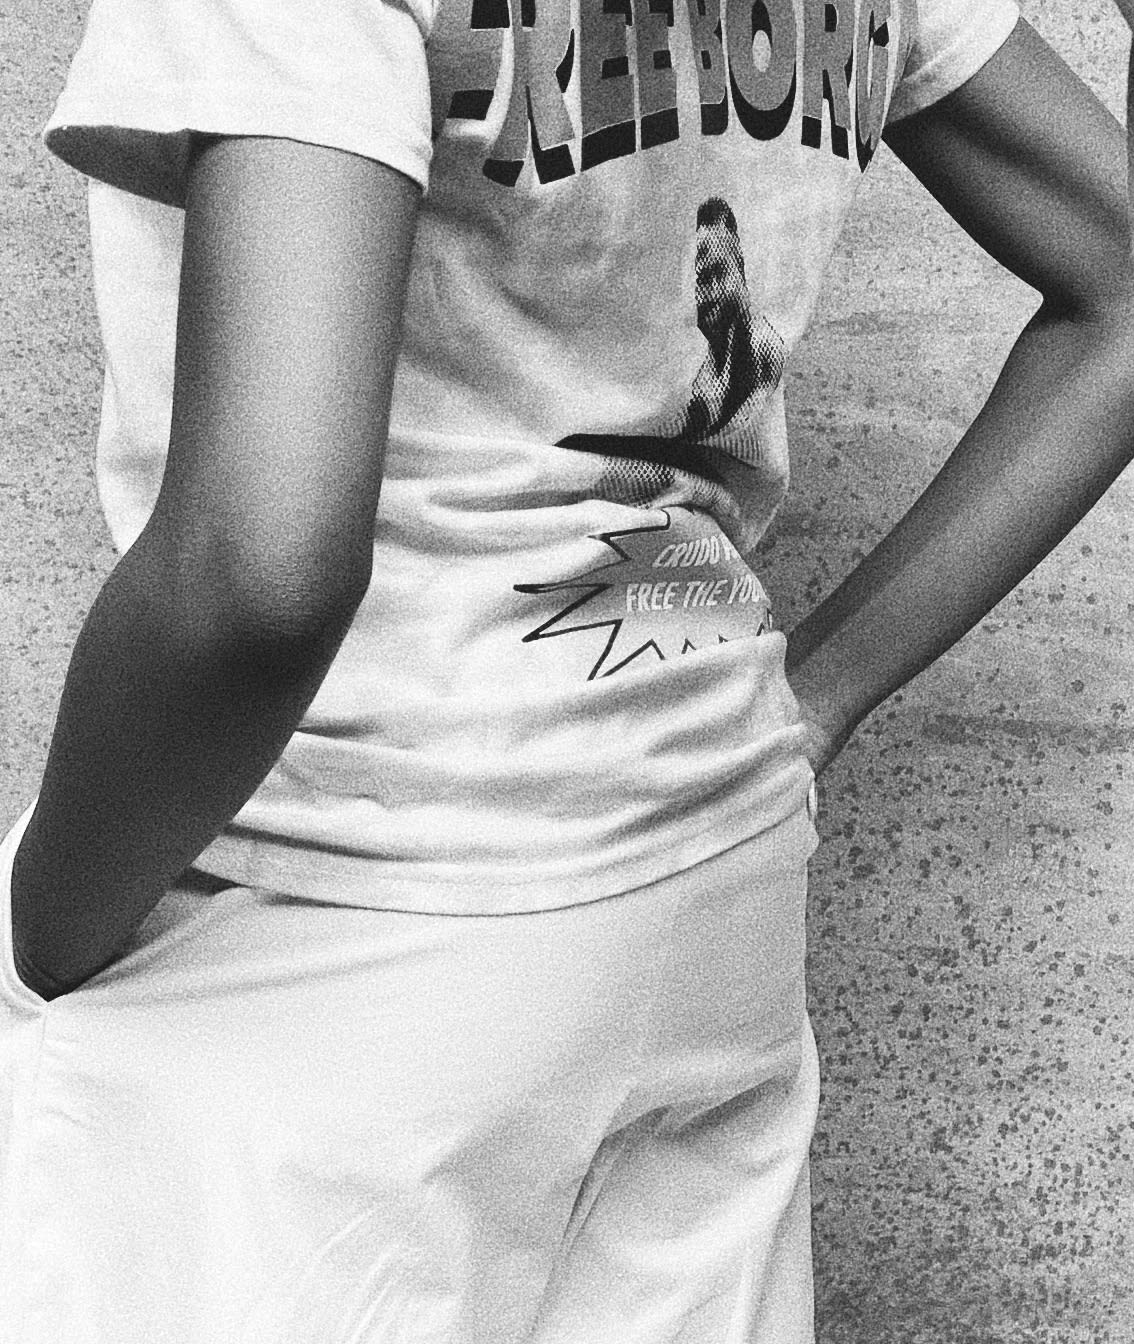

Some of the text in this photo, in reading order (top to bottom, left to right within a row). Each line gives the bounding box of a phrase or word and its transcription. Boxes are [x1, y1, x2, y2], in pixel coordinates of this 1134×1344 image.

[626, 574, 767, 613] FREE THE YOU
